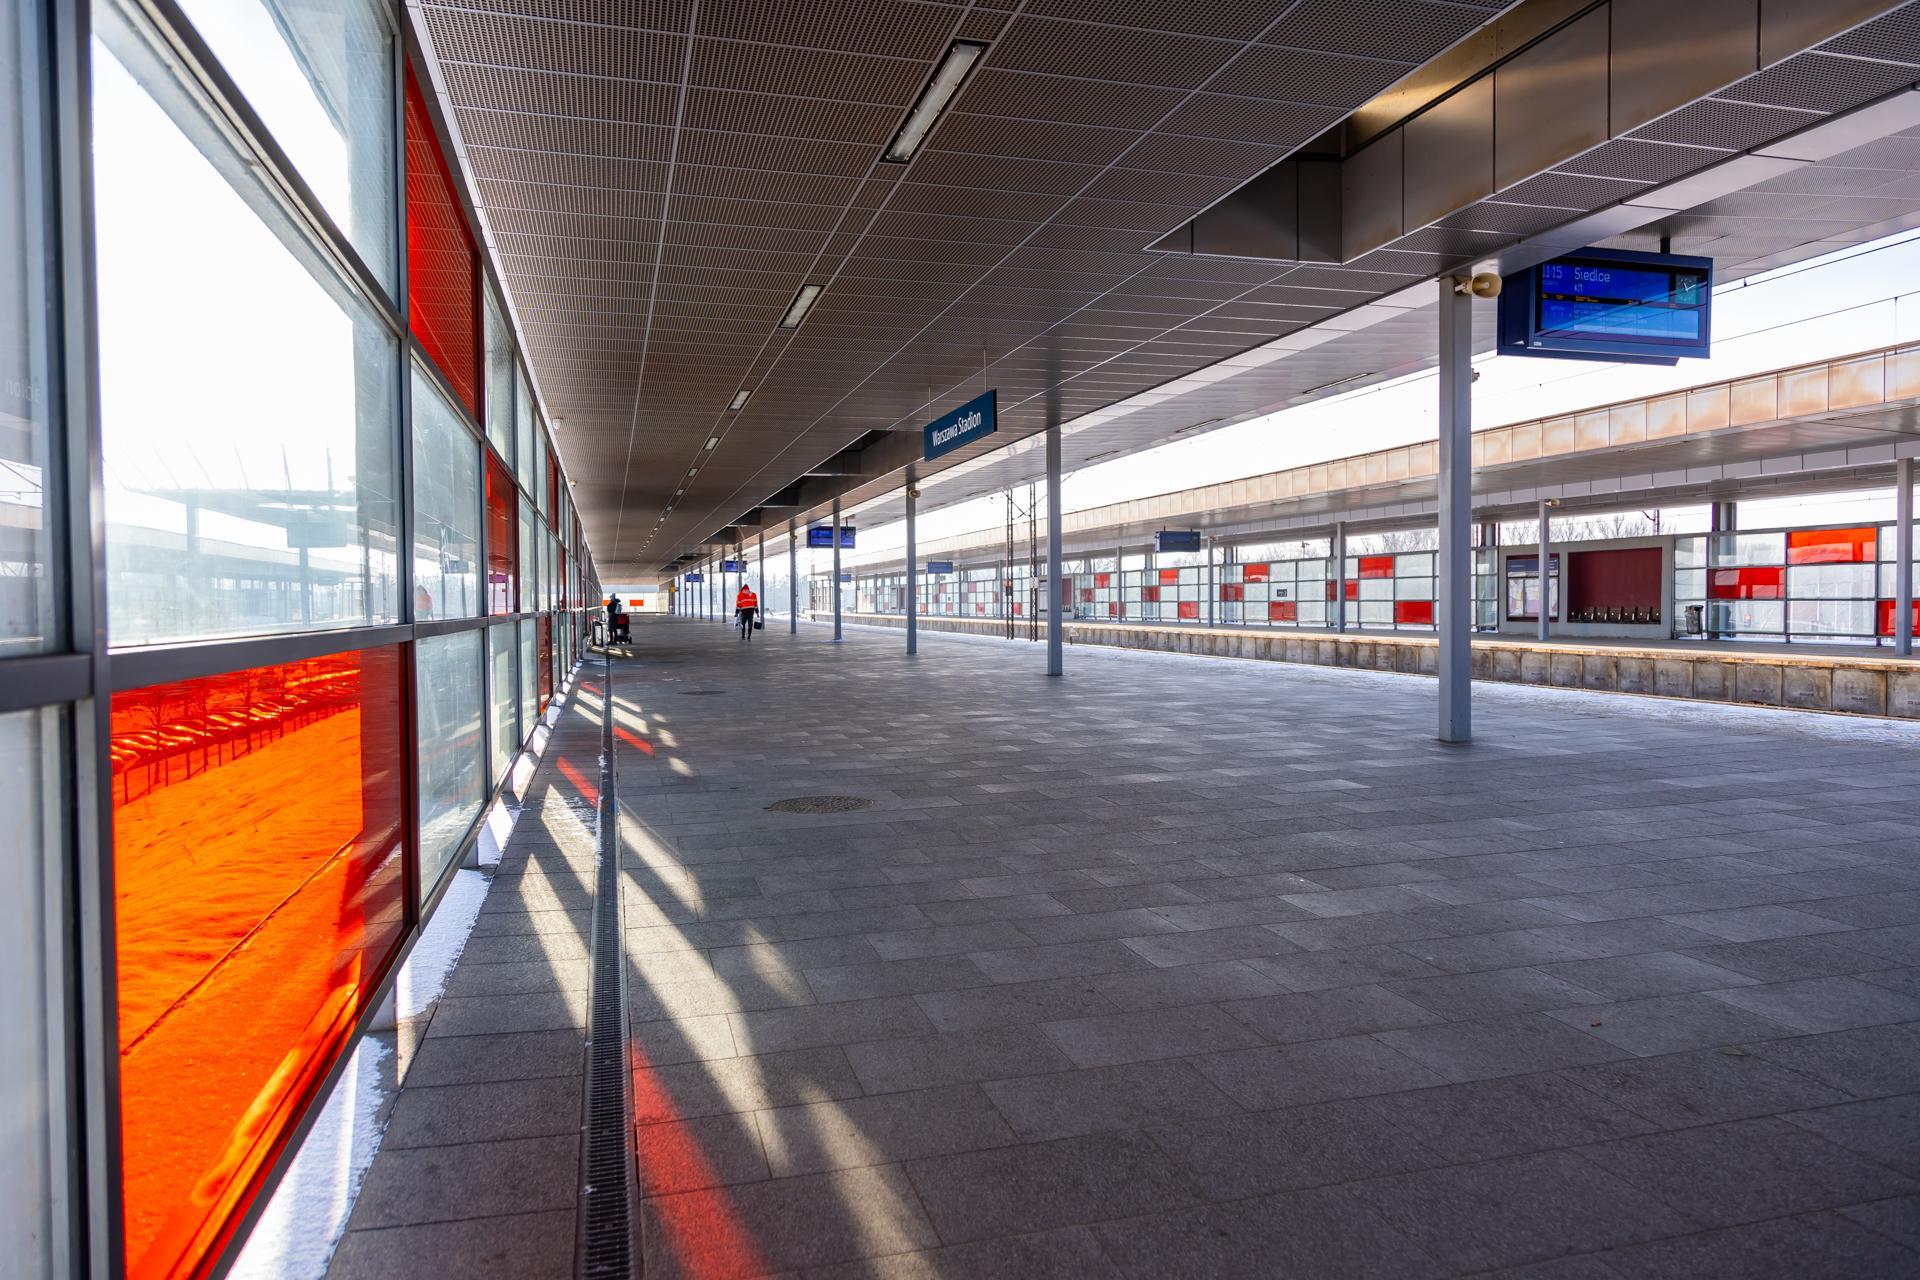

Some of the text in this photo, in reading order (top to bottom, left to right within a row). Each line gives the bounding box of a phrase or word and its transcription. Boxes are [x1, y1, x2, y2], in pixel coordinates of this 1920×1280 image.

[1574, 267, 1611, 283] Siedlce
[932, 411, 981, 446] Warszawa Stadion
